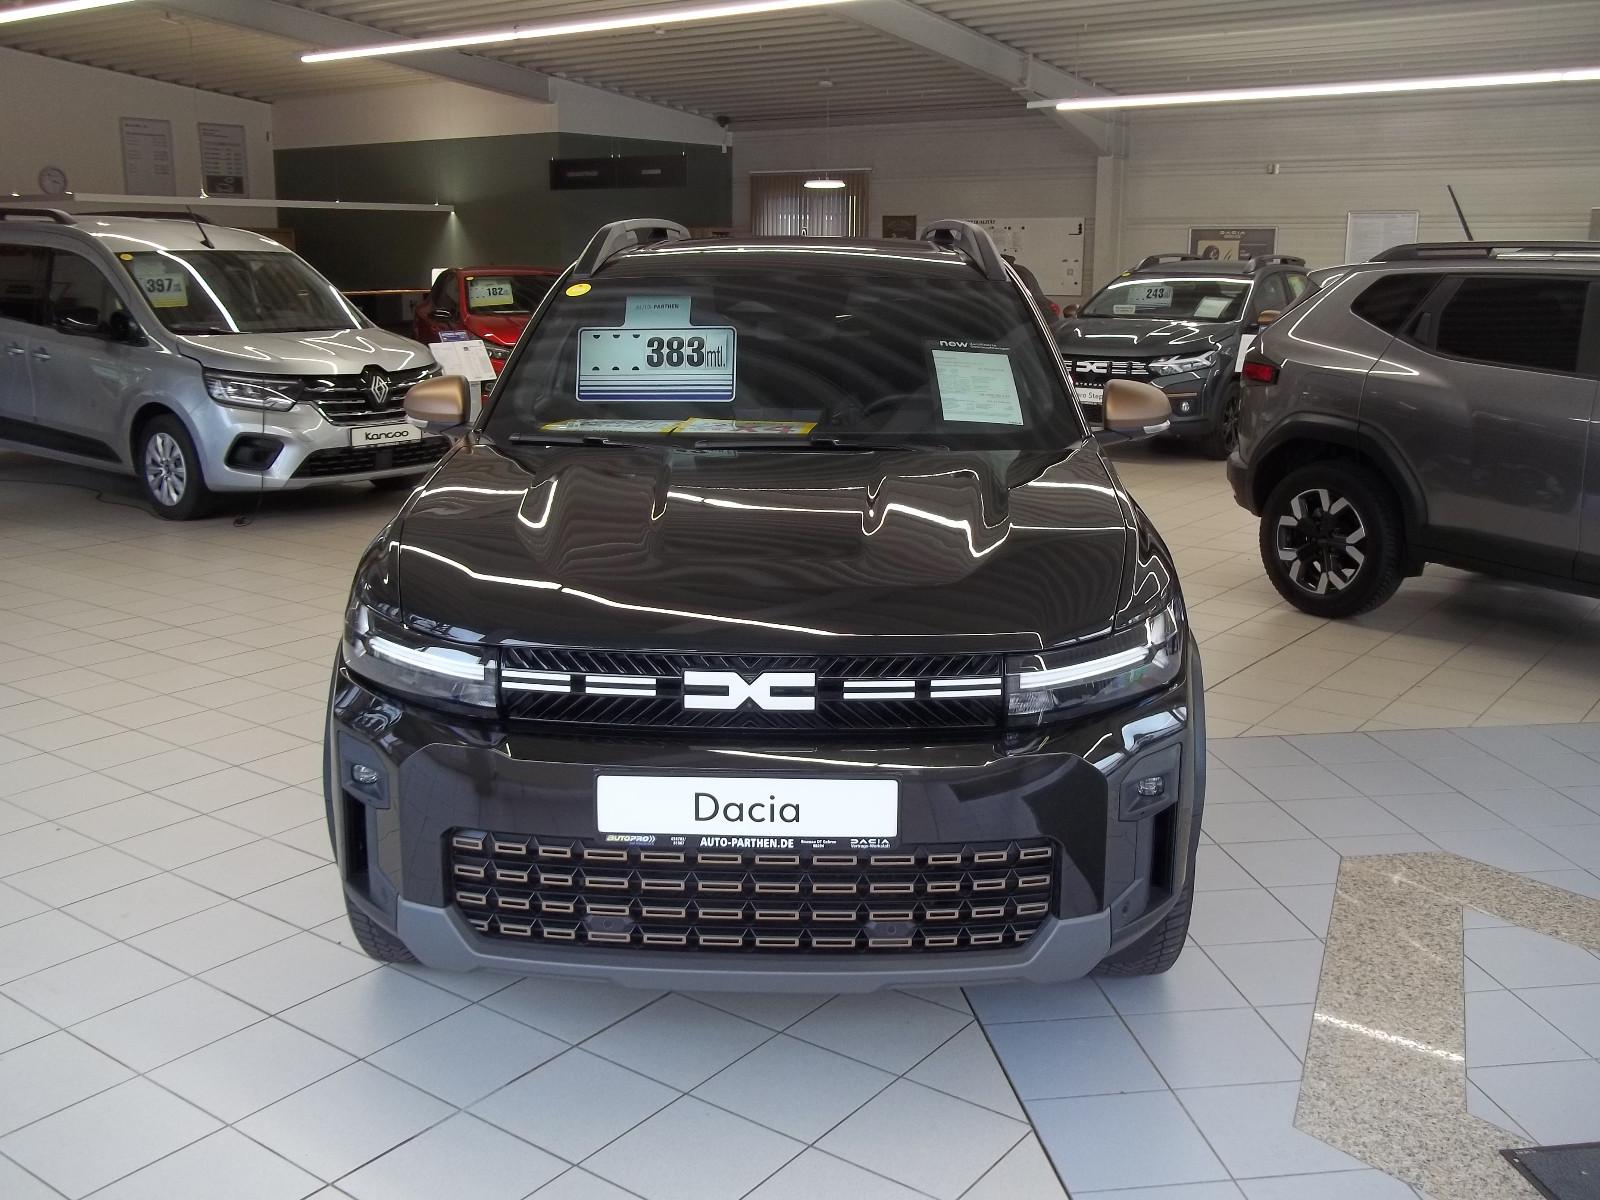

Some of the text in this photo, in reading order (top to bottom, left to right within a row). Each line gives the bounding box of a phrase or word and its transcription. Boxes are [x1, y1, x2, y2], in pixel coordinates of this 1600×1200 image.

[146, 278, 173, 293] 397
[487, 287, 504, 296] 182
[1146, 287, 1165, 299] 243
[646, 336, 726, 368] 383 mtl.
[694, 792, 800, 823] Dacia
[700, 836, 795, 849] AUTO-PARTHEN.DE
